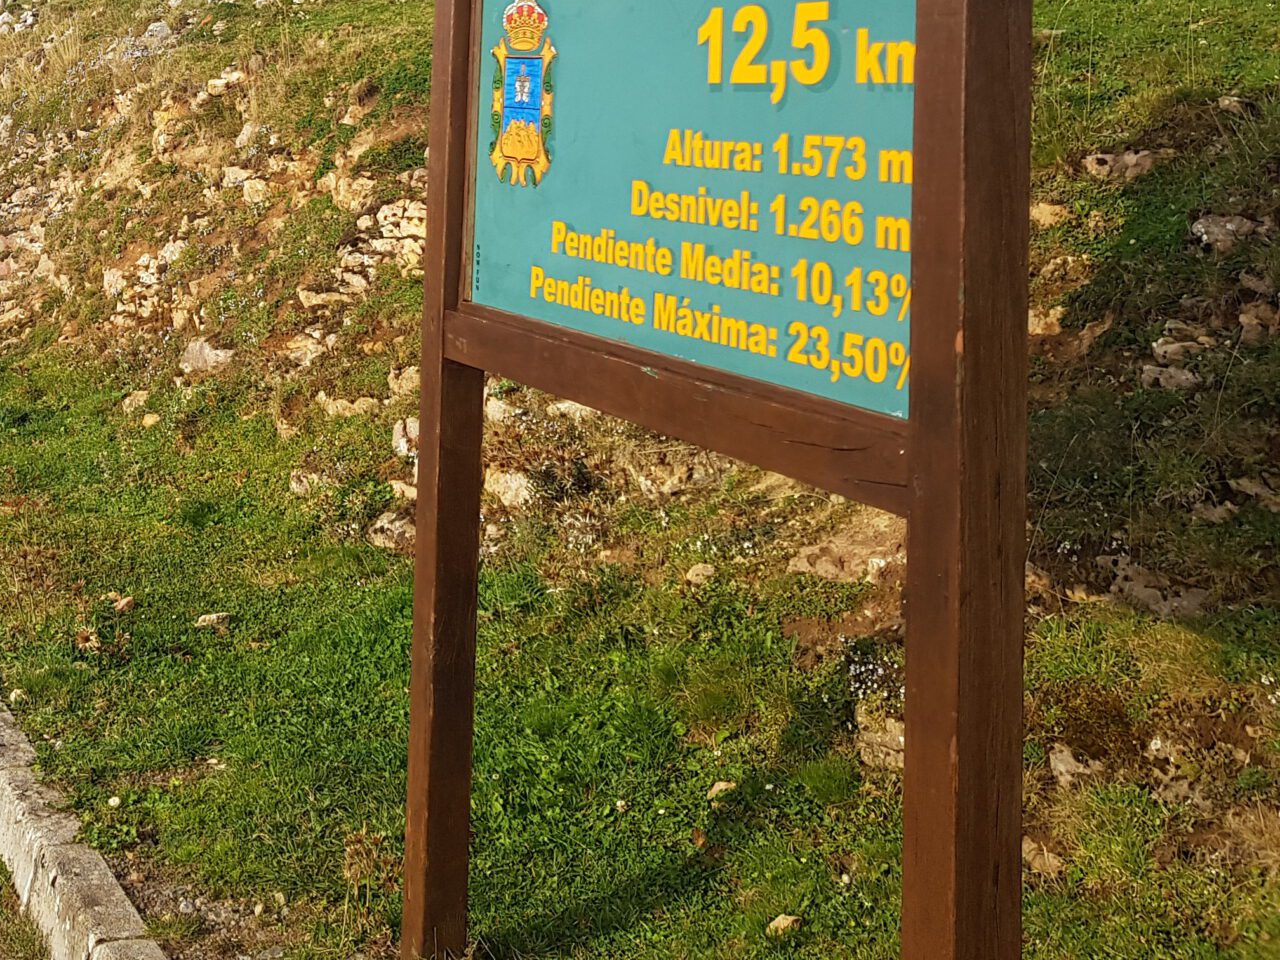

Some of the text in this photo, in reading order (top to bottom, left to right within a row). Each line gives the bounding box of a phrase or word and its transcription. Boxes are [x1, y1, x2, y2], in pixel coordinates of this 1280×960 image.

[697, 1, 917, 104] 12,5 km
[662, 128, 914, 184] Altura: 1.573 m
[630, 178, 912, 252] Desnivel: 1.266 m
[551, 220, 673, 276] Pendiente
[680, 241, 780, 296] Media:
[529, 265, 646, 325] Pendiente
[653, 292, 778, 357] Máxima:
